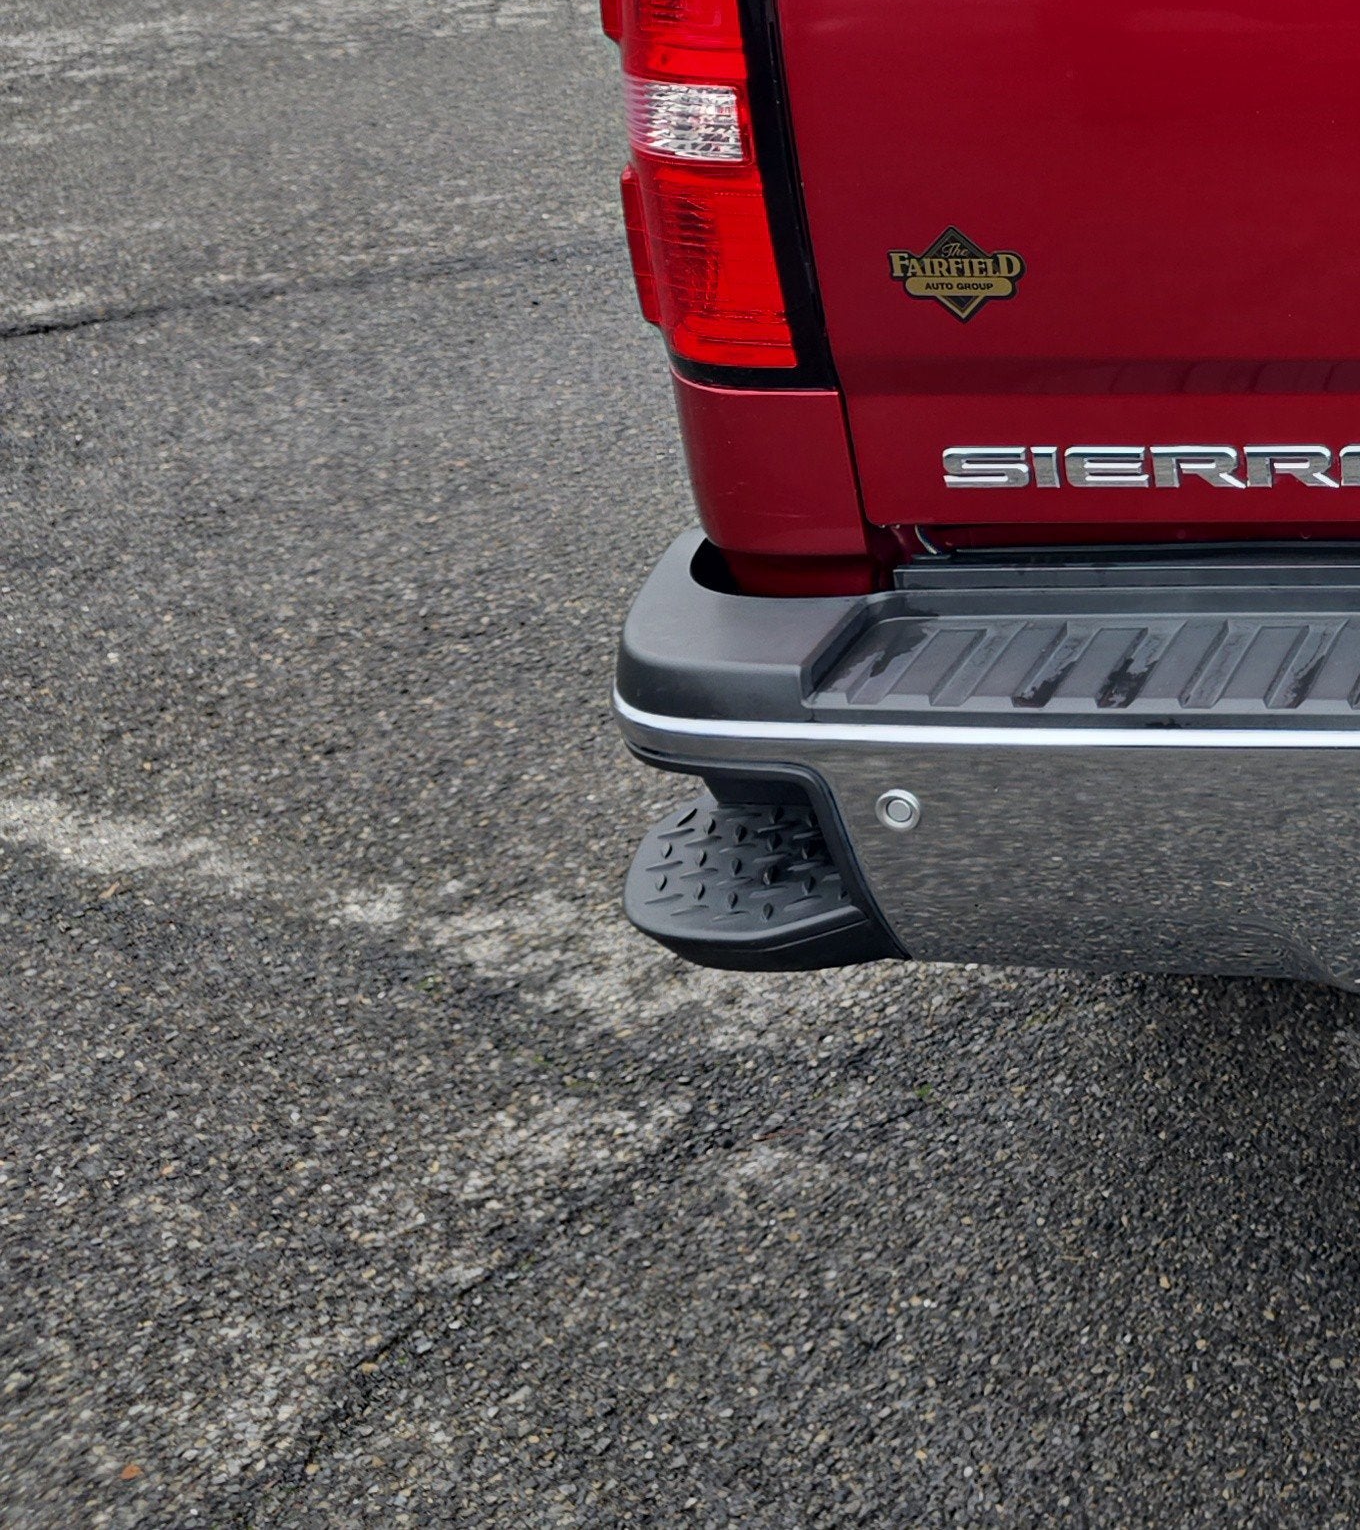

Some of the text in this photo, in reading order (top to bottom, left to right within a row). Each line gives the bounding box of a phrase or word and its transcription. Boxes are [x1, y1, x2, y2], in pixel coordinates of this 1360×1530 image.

[941, 242, 969, 258] The
[889, 252, 1021, 277] FAIRFIELD
[925, 282, 994, 291] AUTO GROUP
